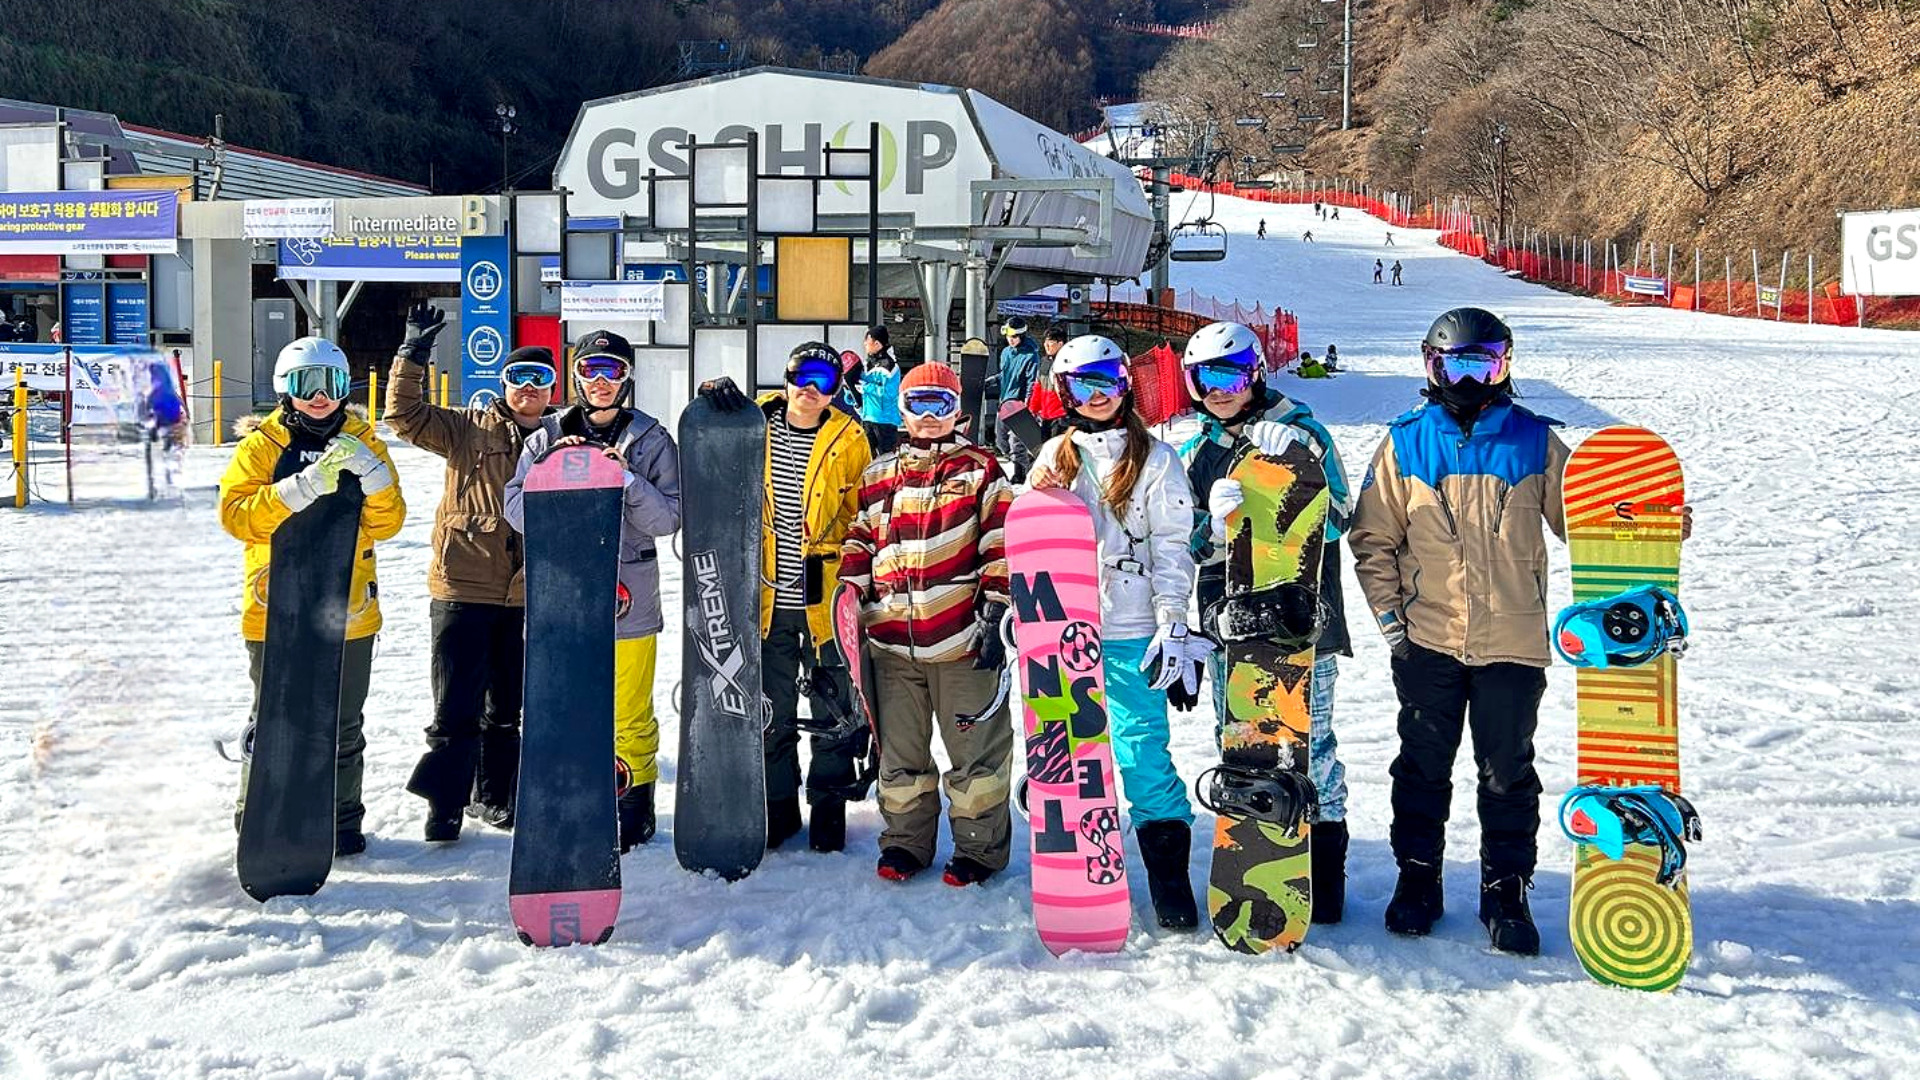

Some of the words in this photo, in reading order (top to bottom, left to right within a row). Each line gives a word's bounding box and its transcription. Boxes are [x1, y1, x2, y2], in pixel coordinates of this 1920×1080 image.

[19, 203, 51, 218] 보호구
[54, 202, 86, 218] 착용을
[89, 201, 122, 218] 생활화
[125, 200, 159, 218] 합시다
[348, 215, 458, 232] intermediate
[462, 195, 487, 235] B
[22, 221, 64, 233] protective
[66, 222, 86, 232] gear
[405, 251, 434, 260] Please
[437, 252, 459, 260] wear
[692, 551, 748, 716] EXTREME
